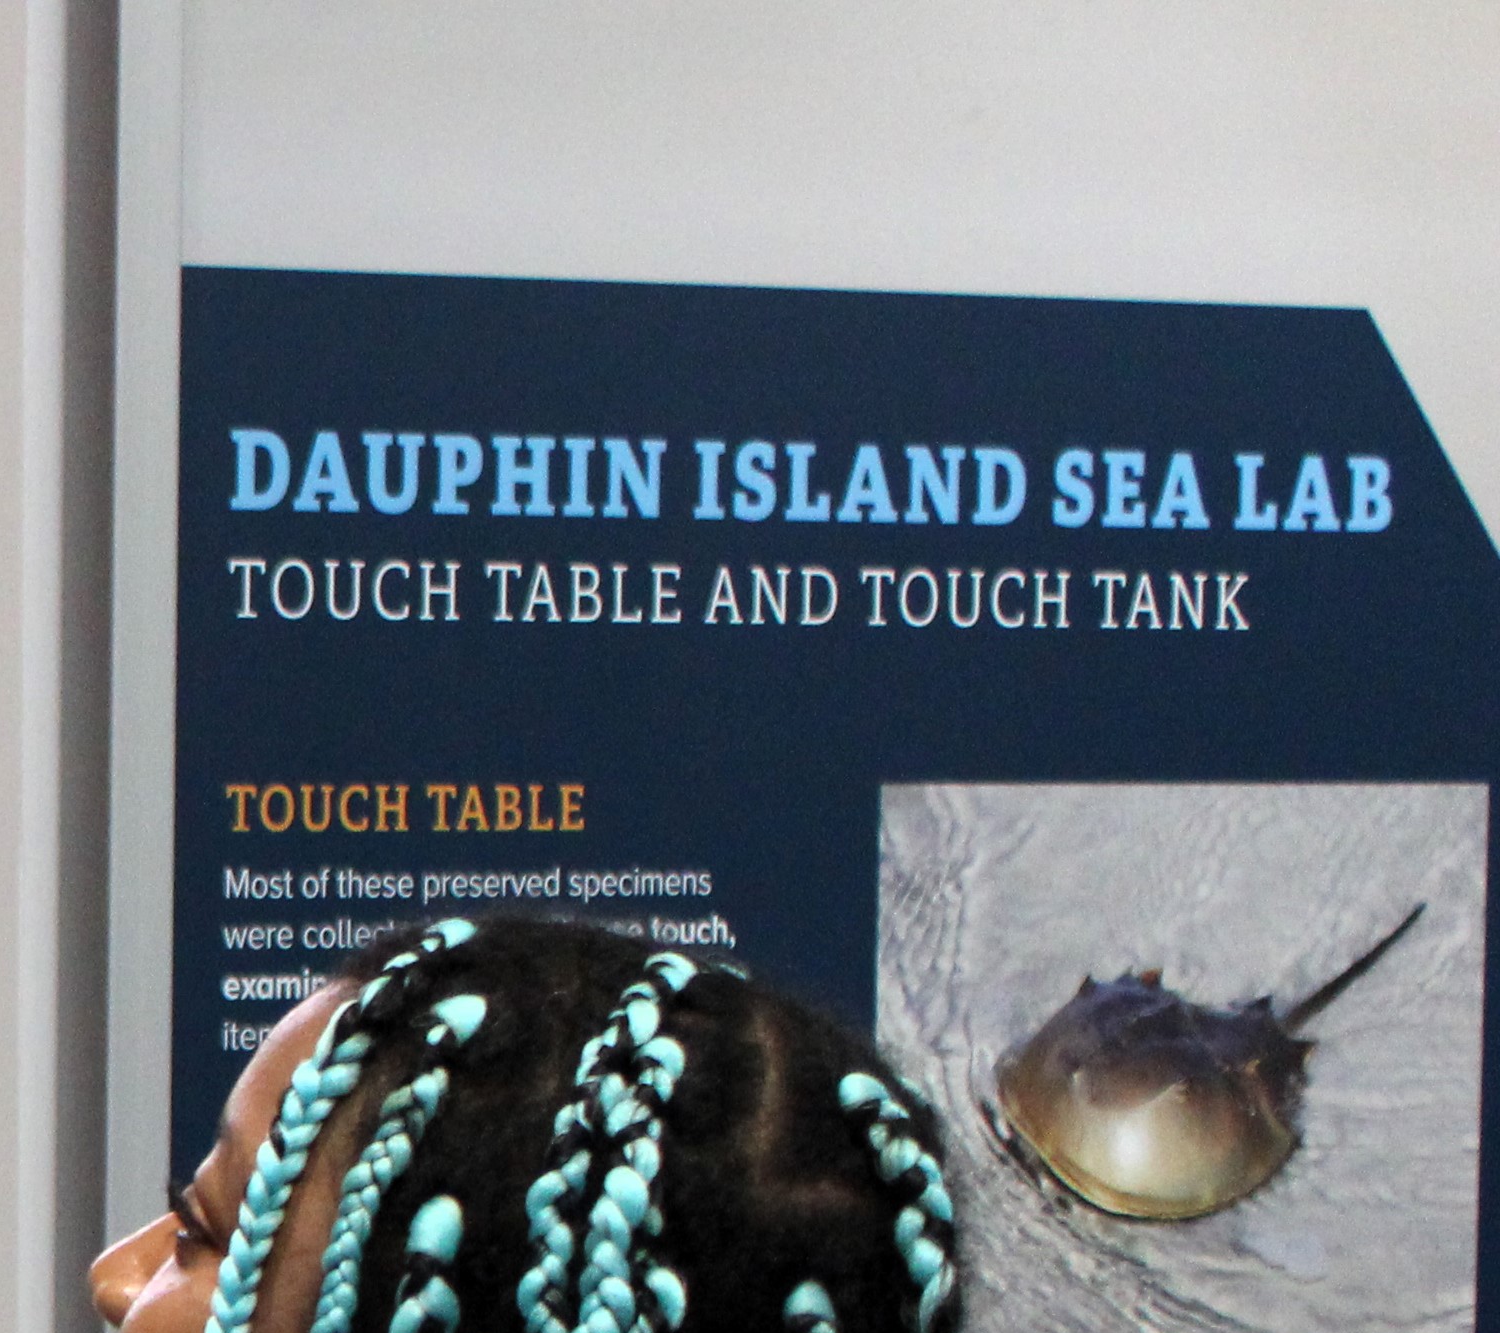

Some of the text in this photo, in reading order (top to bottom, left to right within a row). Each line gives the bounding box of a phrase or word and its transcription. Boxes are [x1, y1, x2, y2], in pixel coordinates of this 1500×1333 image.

[229, 427, 1394, 533] DAUPHIN ISLAND SEA LAB
[228, 557, 1251, 632] TOUCH TABLE AND TOUCH TANK
[225, 783, 586, 833] TOUCH TABLE
[224, 867, 713, 905] Most of these preserved specimens
[223, 924, 295, 950] were
[650, 912, 737, 949] touch,
